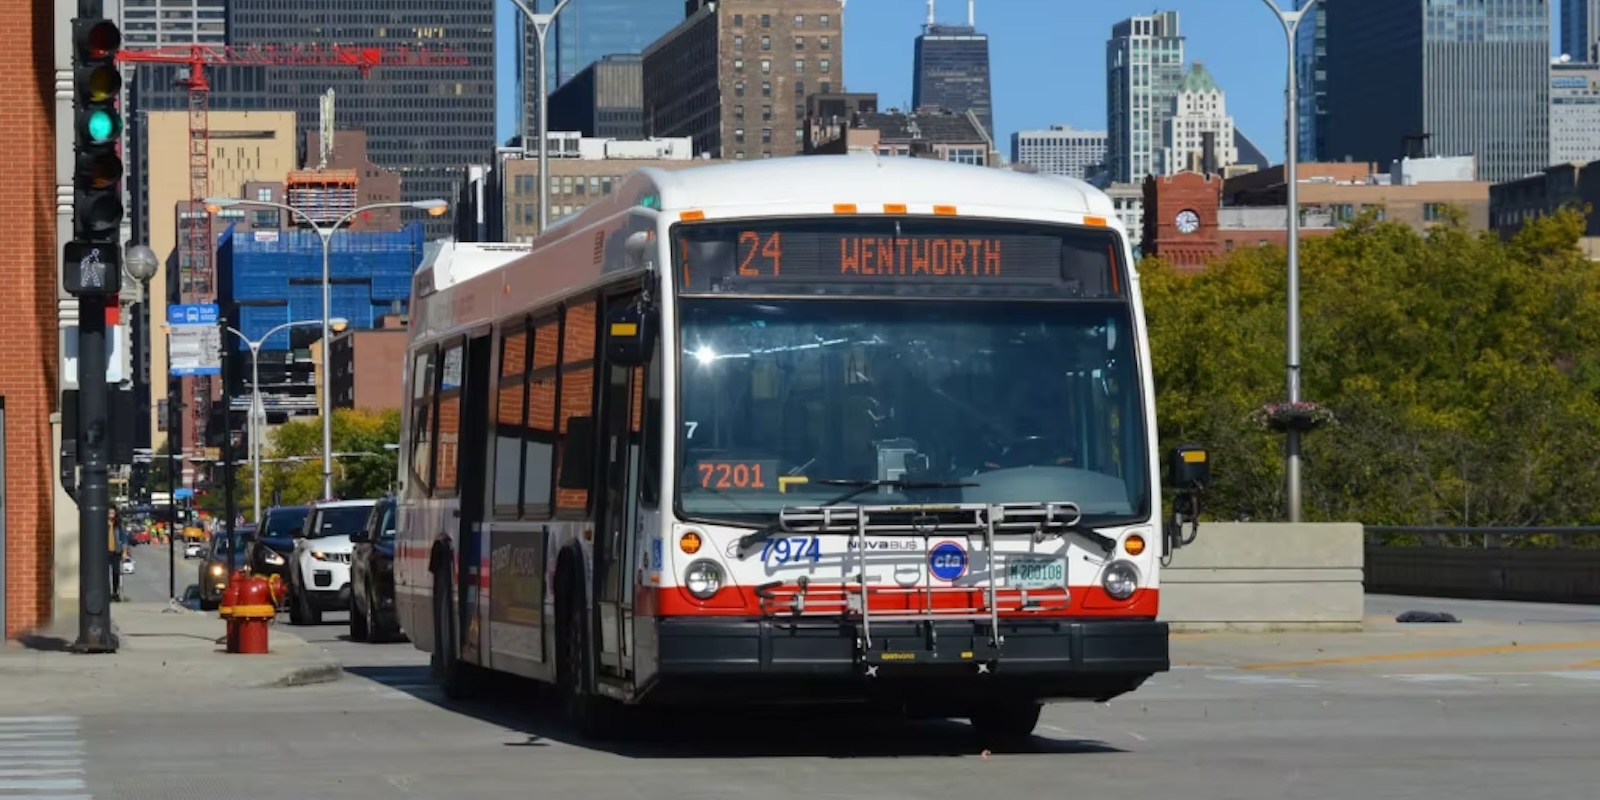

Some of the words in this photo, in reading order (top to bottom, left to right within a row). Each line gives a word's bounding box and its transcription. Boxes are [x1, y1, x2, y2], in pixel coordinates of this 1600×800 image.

[738, 230, 782, 277] 24
[840, 237, 1000, 276] WENTWORTH
[684, 421, 698, 439] 7
[698, 463, 765, 488] 7201
[760, 537, 821, 563] 7974
[934, 554, 961, 568] cta
[1021, 564, 1062, 580] 200108
